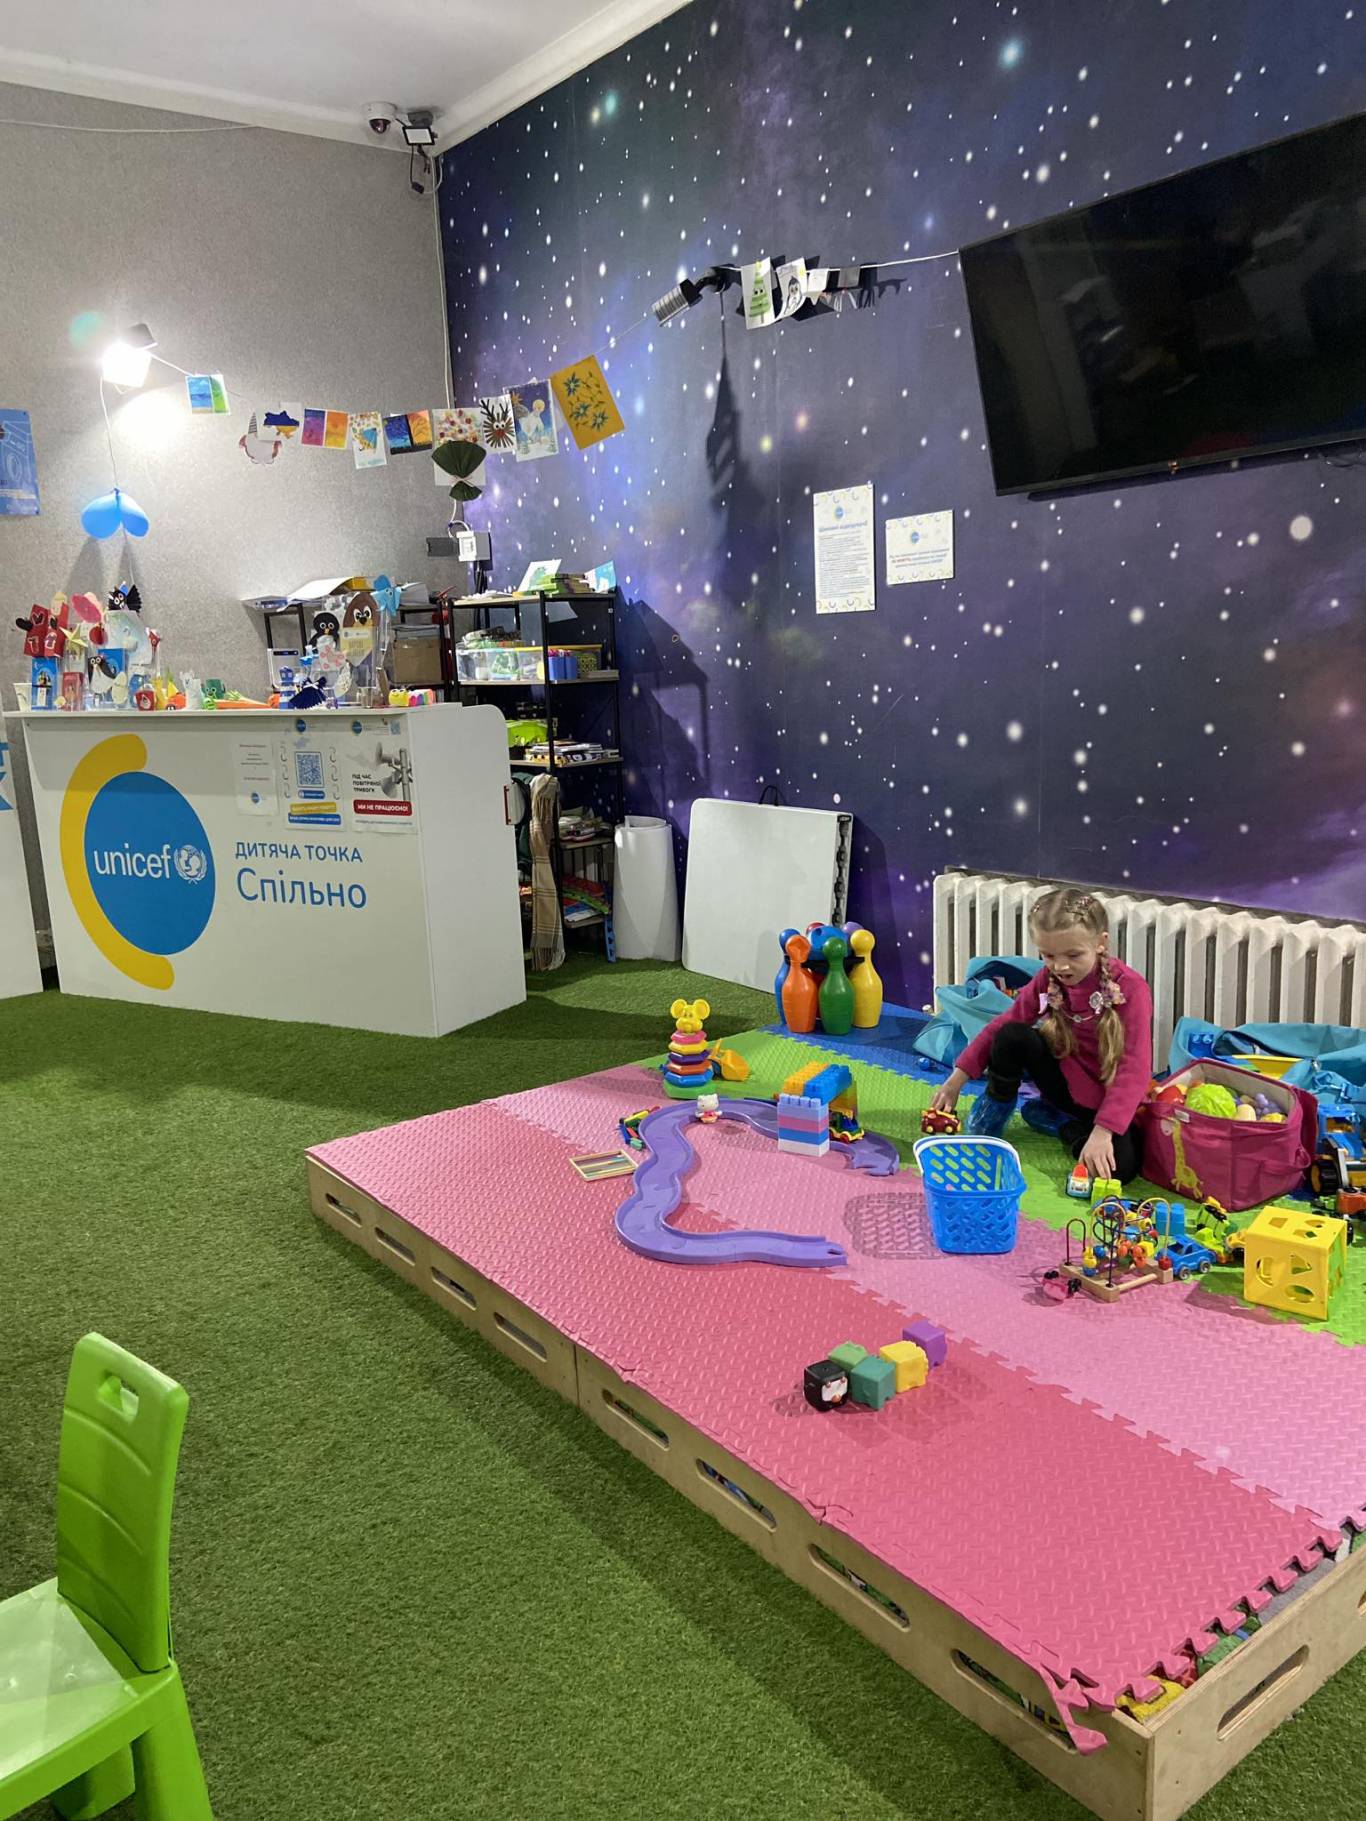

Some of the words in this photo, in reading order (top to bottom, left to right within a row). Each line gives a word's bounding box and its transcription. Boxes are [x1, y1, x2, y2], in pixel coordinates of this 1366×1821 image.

[93, 843, 171, 879] unicef
[235, 841, 301, 860] ДИТЯЧА
[304, 844, 363, 863] ТОЧКА
[236, 867, 368, 909] Спільно
